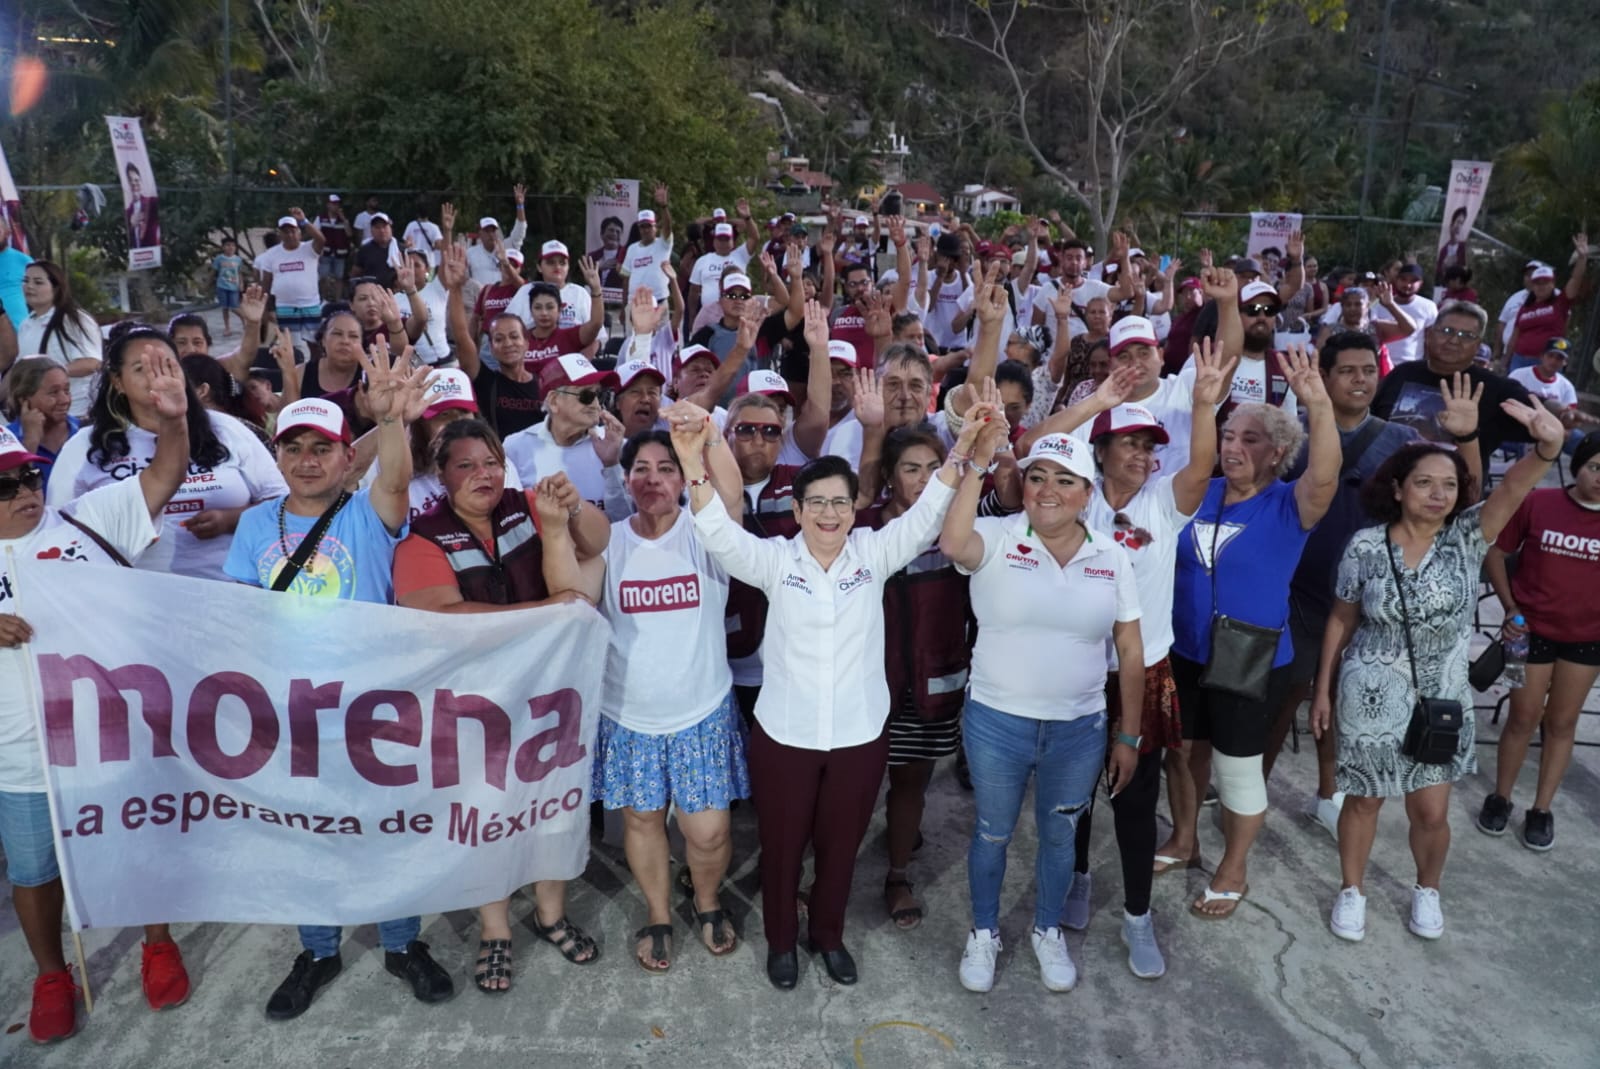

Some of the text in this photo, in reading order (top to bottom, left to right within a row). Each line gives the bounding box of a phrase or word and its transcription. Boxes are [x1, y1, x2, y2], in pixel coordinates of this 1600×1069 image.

[835, 316, 865, 325] more
[526, 346, 559, 358] orena
[291, 405, 329, 414] morena
[188, 485, 222, 494] VALLARTA
[165, 501, 201, 512] rena
[1006, 553, 1039, 567] CHUYITA
[1549, 548, 1588, 560] esperanza
[1084, 567, 1115, 578] morena
[622, 580, 699, 608] morena
[37, 653, 587, 791] morena
[62, 786, 584, 849] a esperanza de México
